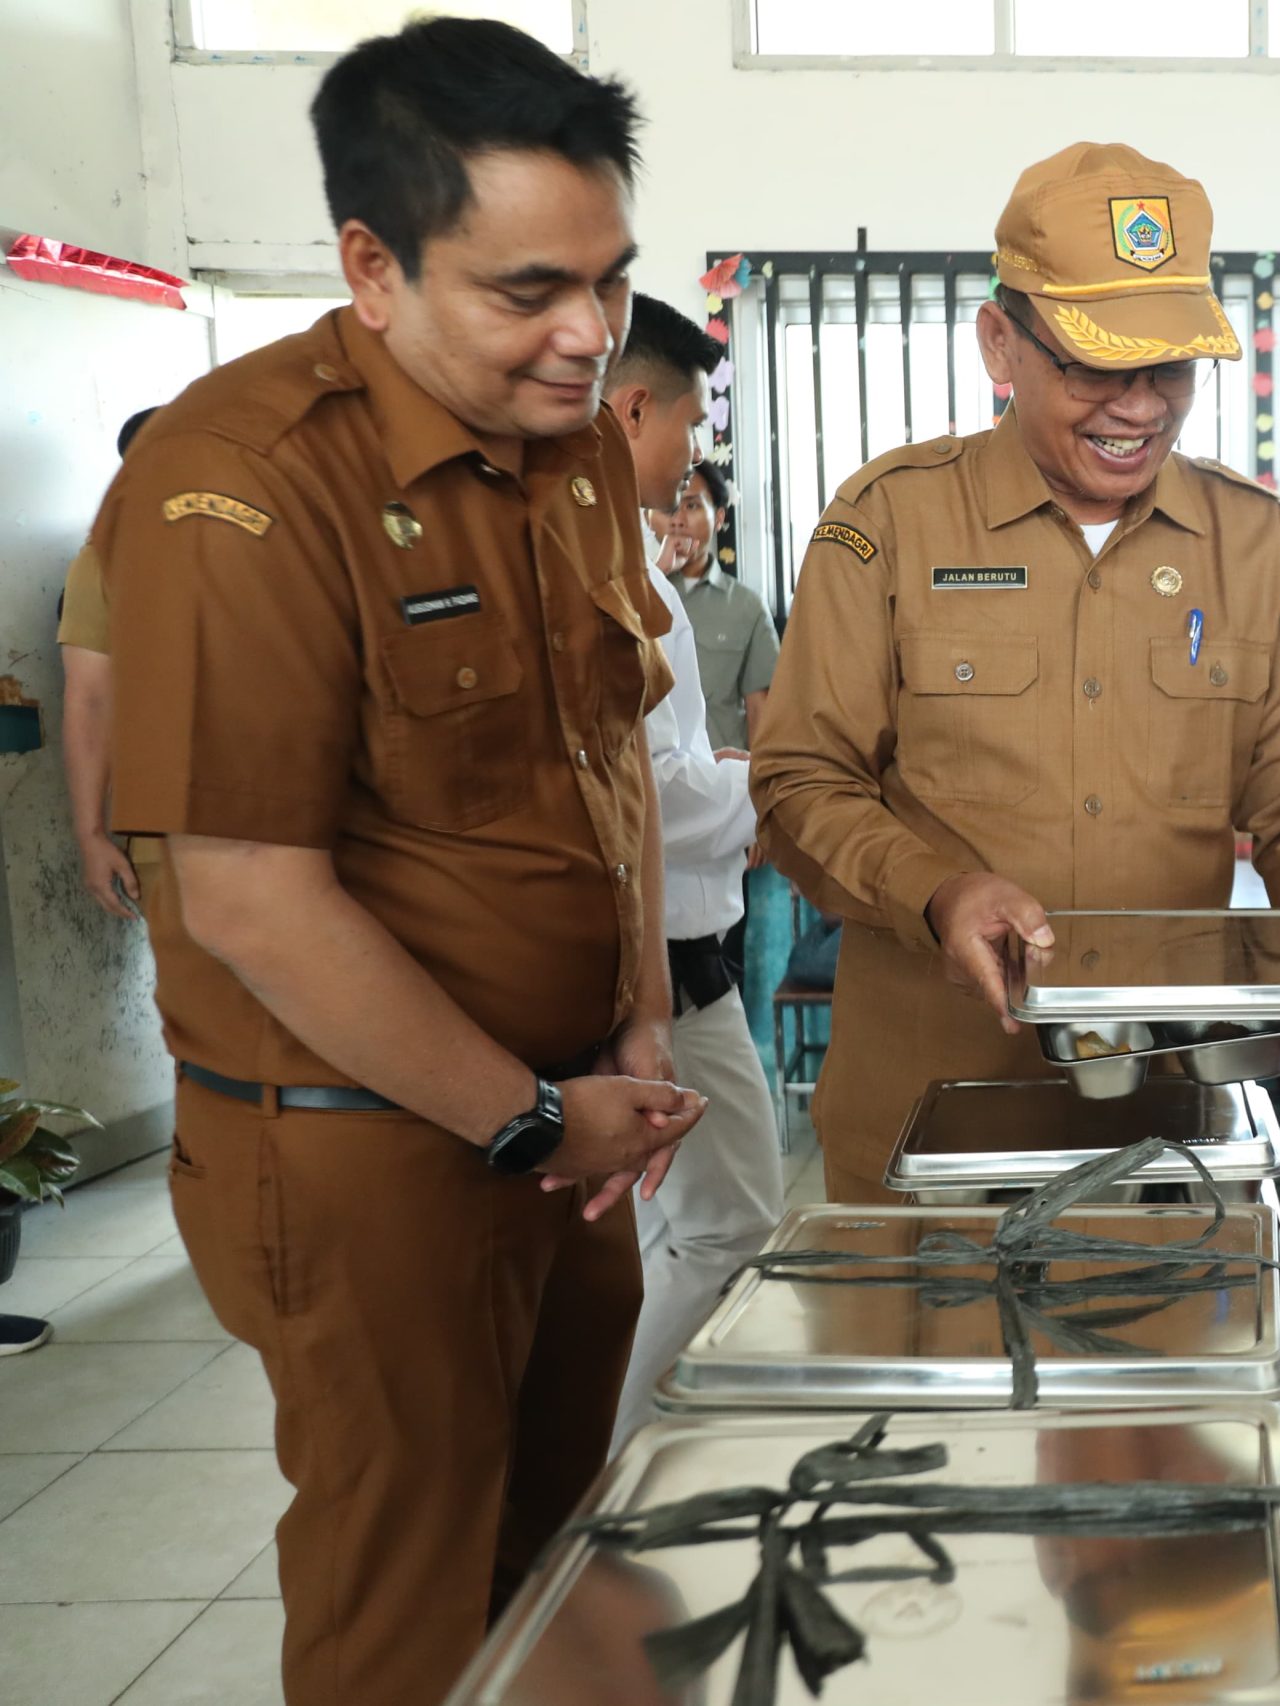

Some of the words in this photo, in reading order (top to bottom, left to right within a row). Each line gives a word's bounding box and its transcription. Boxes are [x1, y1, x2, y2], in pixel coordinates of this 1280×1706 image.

[815, 525, 872, 558] KEMENDAGRI
[942, 573, 975, 582] JALAN
[977, 572, 1017, 582] BERUTU
